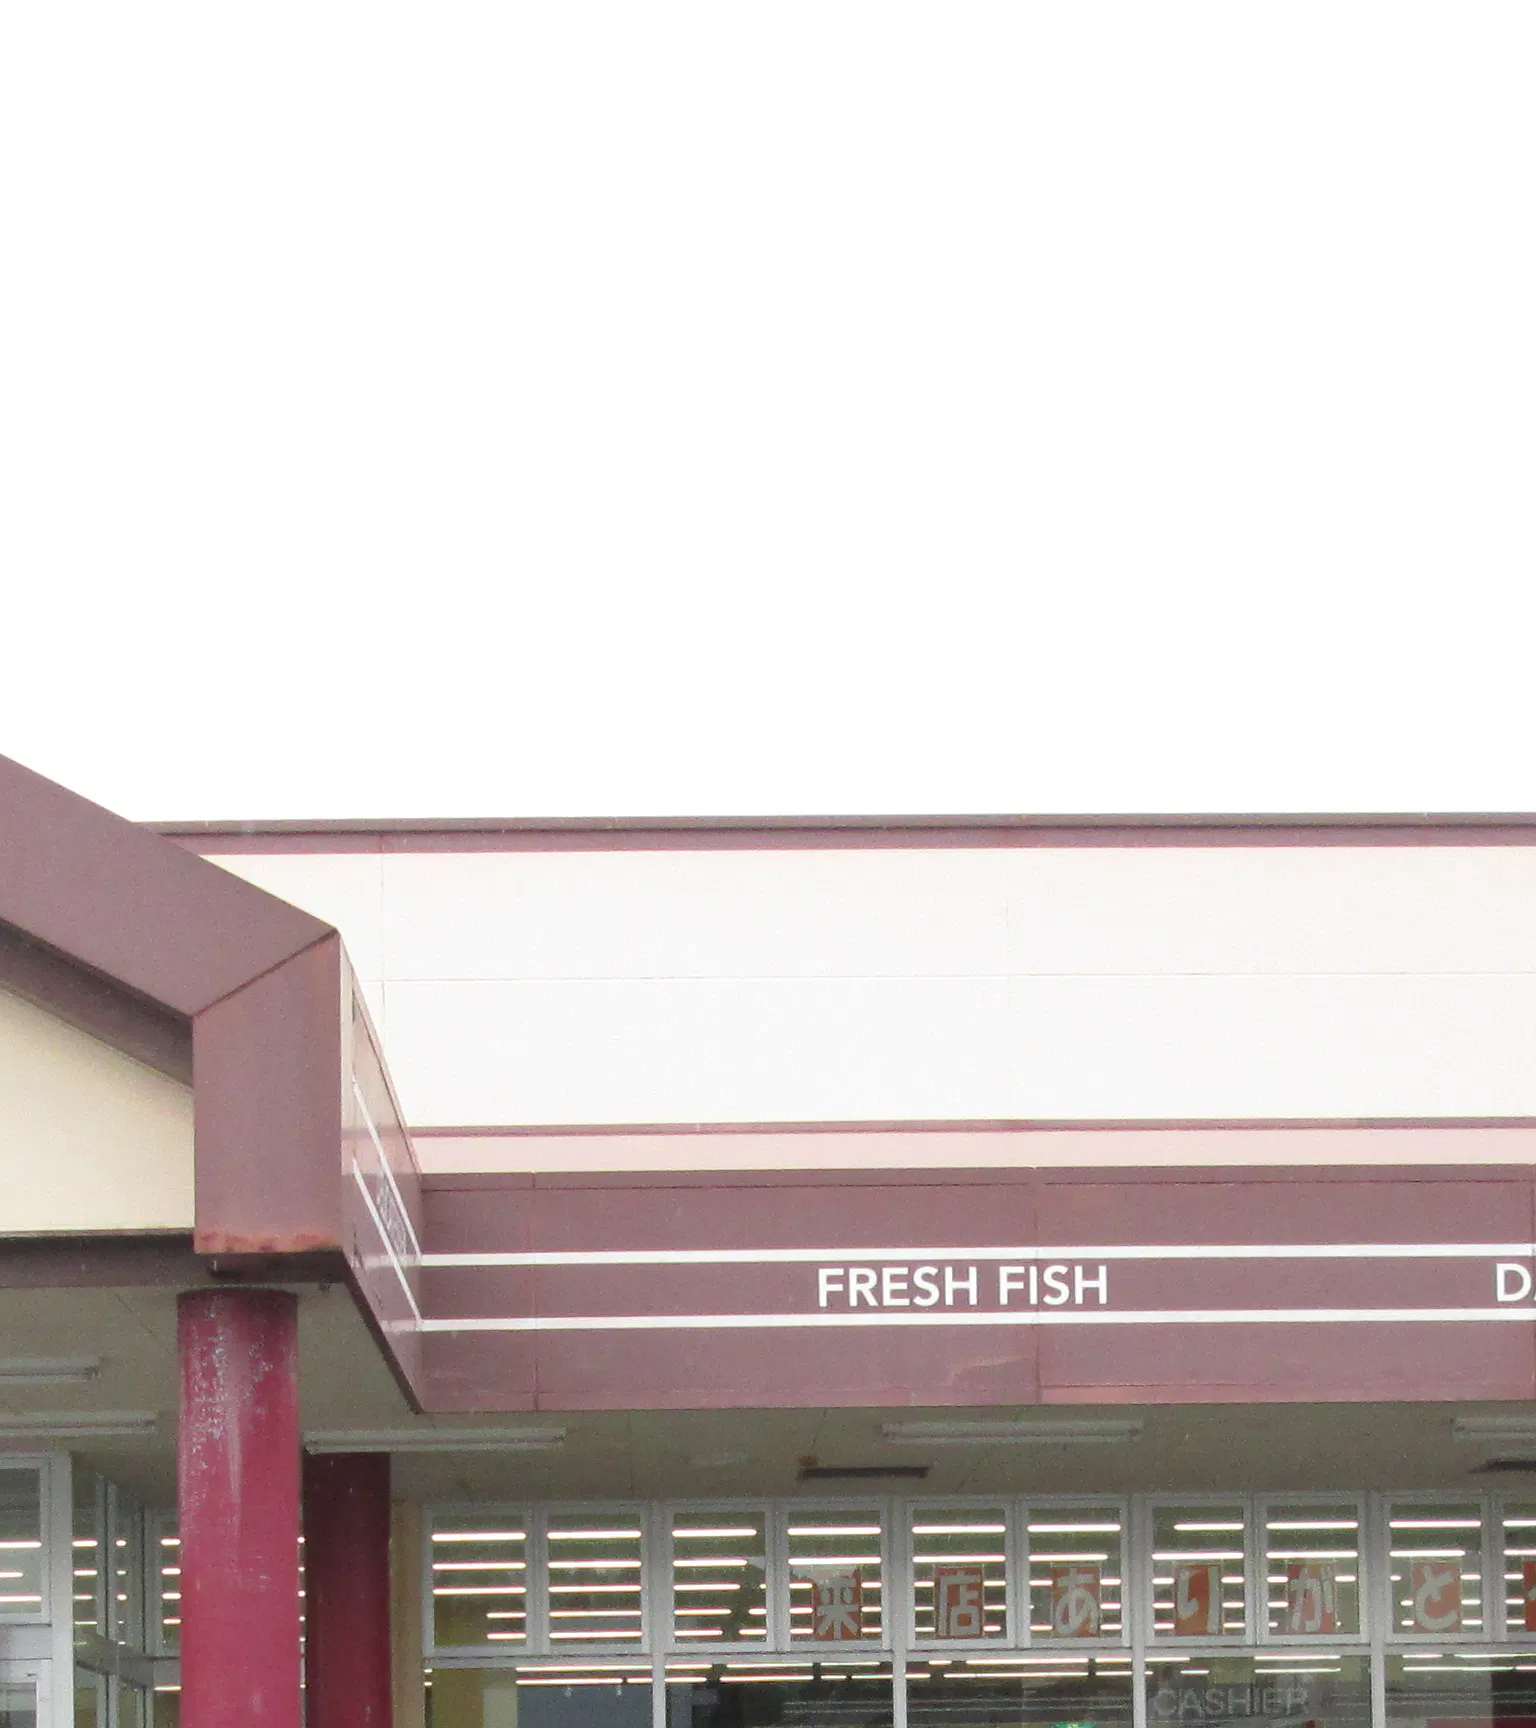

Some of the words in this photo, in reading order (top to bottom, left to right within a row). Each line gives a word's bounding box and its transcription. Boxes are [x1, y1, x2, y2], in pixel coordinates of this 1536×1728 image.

[818, 1266, 978, 1307] FRESH
[999, 1265, 1108, 1305] FISH
[1153, 1687, 1310, 1717] CASHIER
